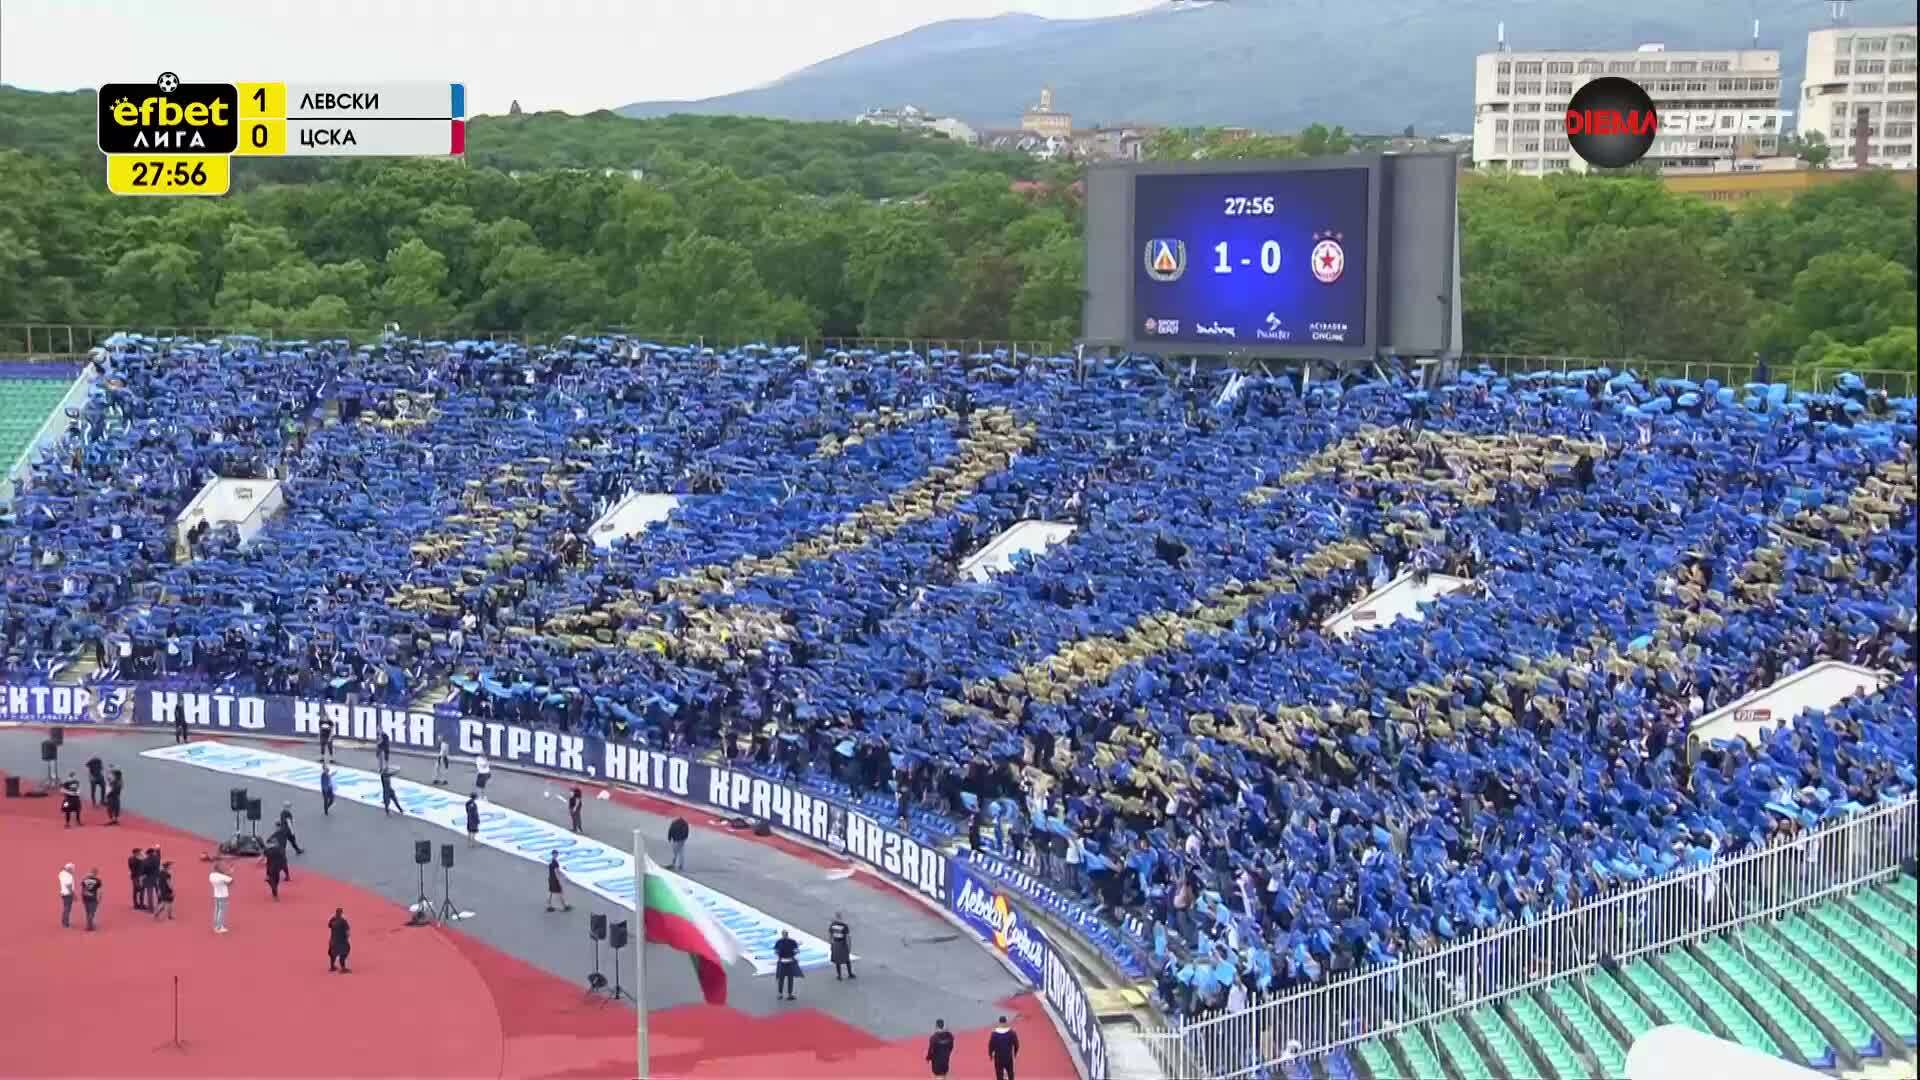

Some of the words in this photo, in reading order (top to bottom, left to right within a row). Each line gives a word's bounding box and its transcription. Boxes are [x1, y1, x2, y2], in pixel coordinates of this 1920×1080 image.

[1224, 197, 1274, 215] 27:56
[1214, 240, 1232, 274] 1
[1261, 240, 1281, 274] 0
[151, 691, 266, 729] НИТО
[458, 718, 596, 777] СТРАХ,
[604, 742, 689, 795] НИТО
[846, 811, 946, 899] НАЗАД!
